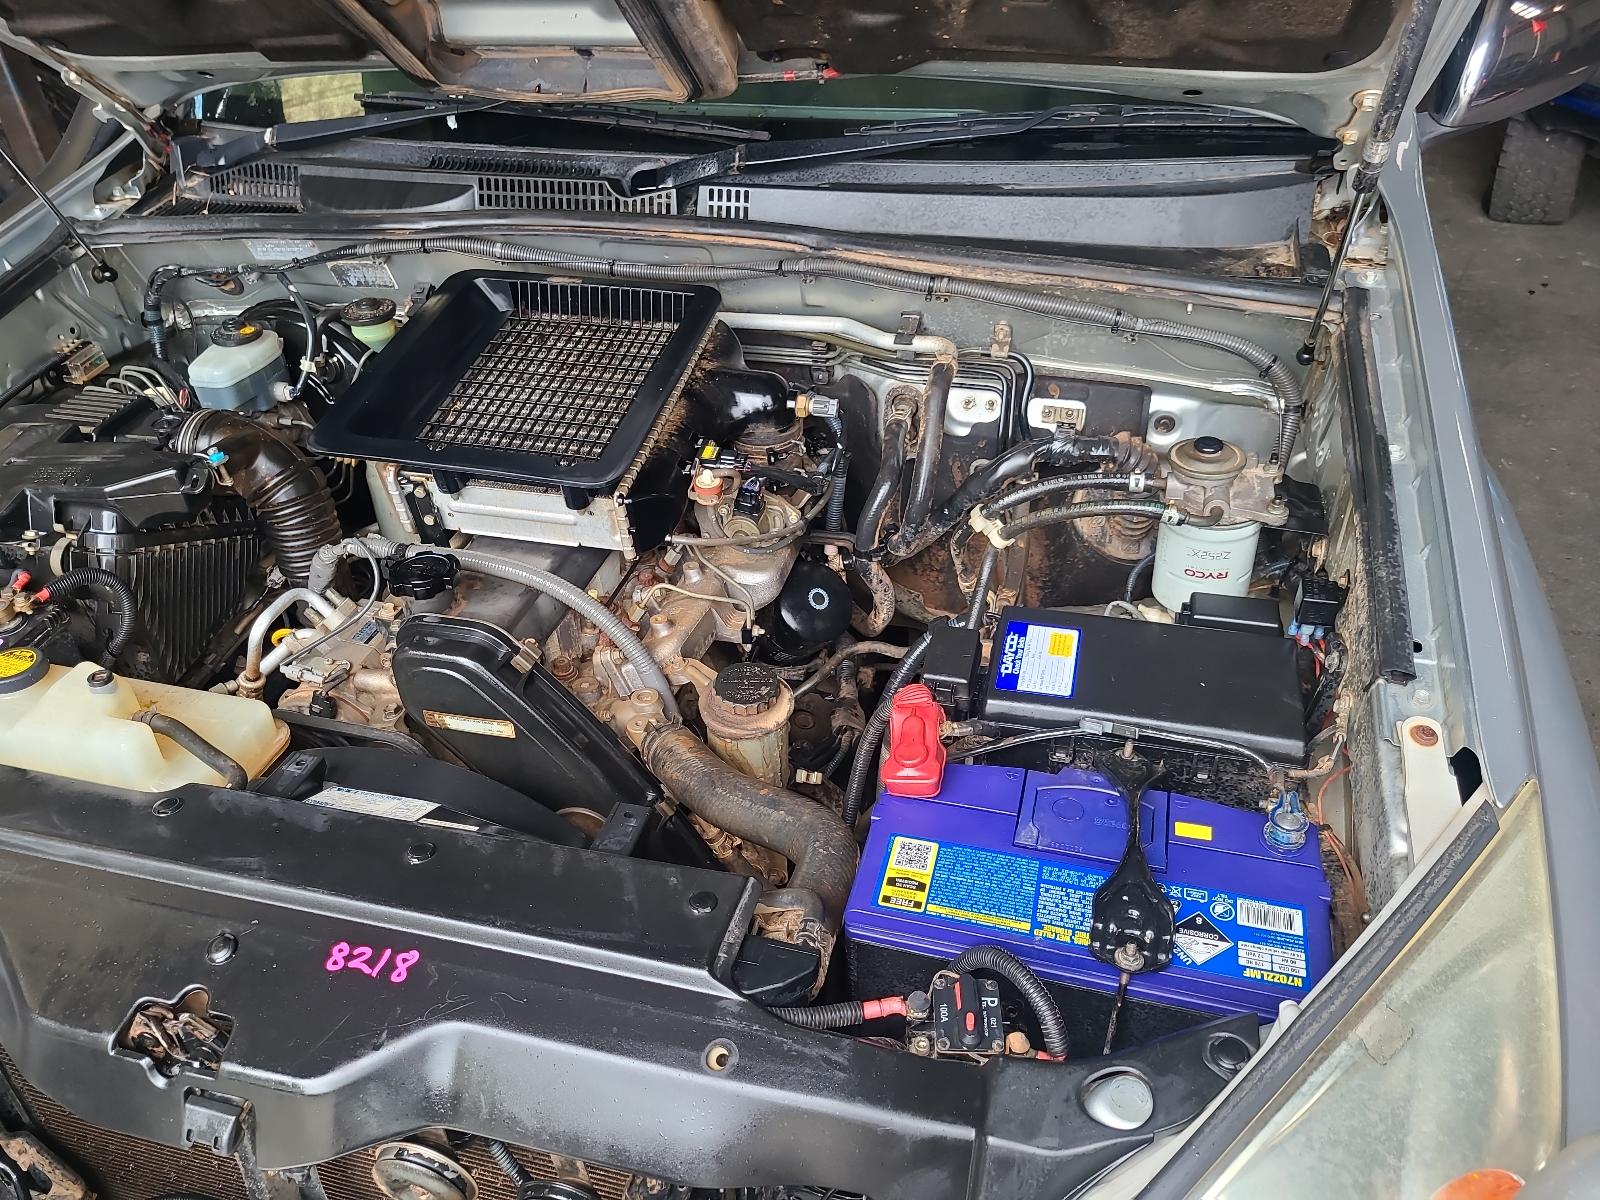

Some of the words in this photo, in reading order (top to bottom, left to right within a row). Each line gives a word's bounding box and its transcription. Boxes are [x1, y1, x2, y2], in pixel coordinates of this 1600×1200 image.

[1184, 568, 1229, 580] RYCO
[1001, 632, 1018, 678] DAYCO
[890, 897, 914, 907] FREE
[1195, 917, 1203, 925] 8
[1034, 929, 1055, 940] FILLED
[1178, 928, 1220, 940] CORROSIVE
[1242, 967, 1303, 987] N70ZZLMF
[981, 997, 998, 1007] P
[939, 1003, 949, 1023] 100A
